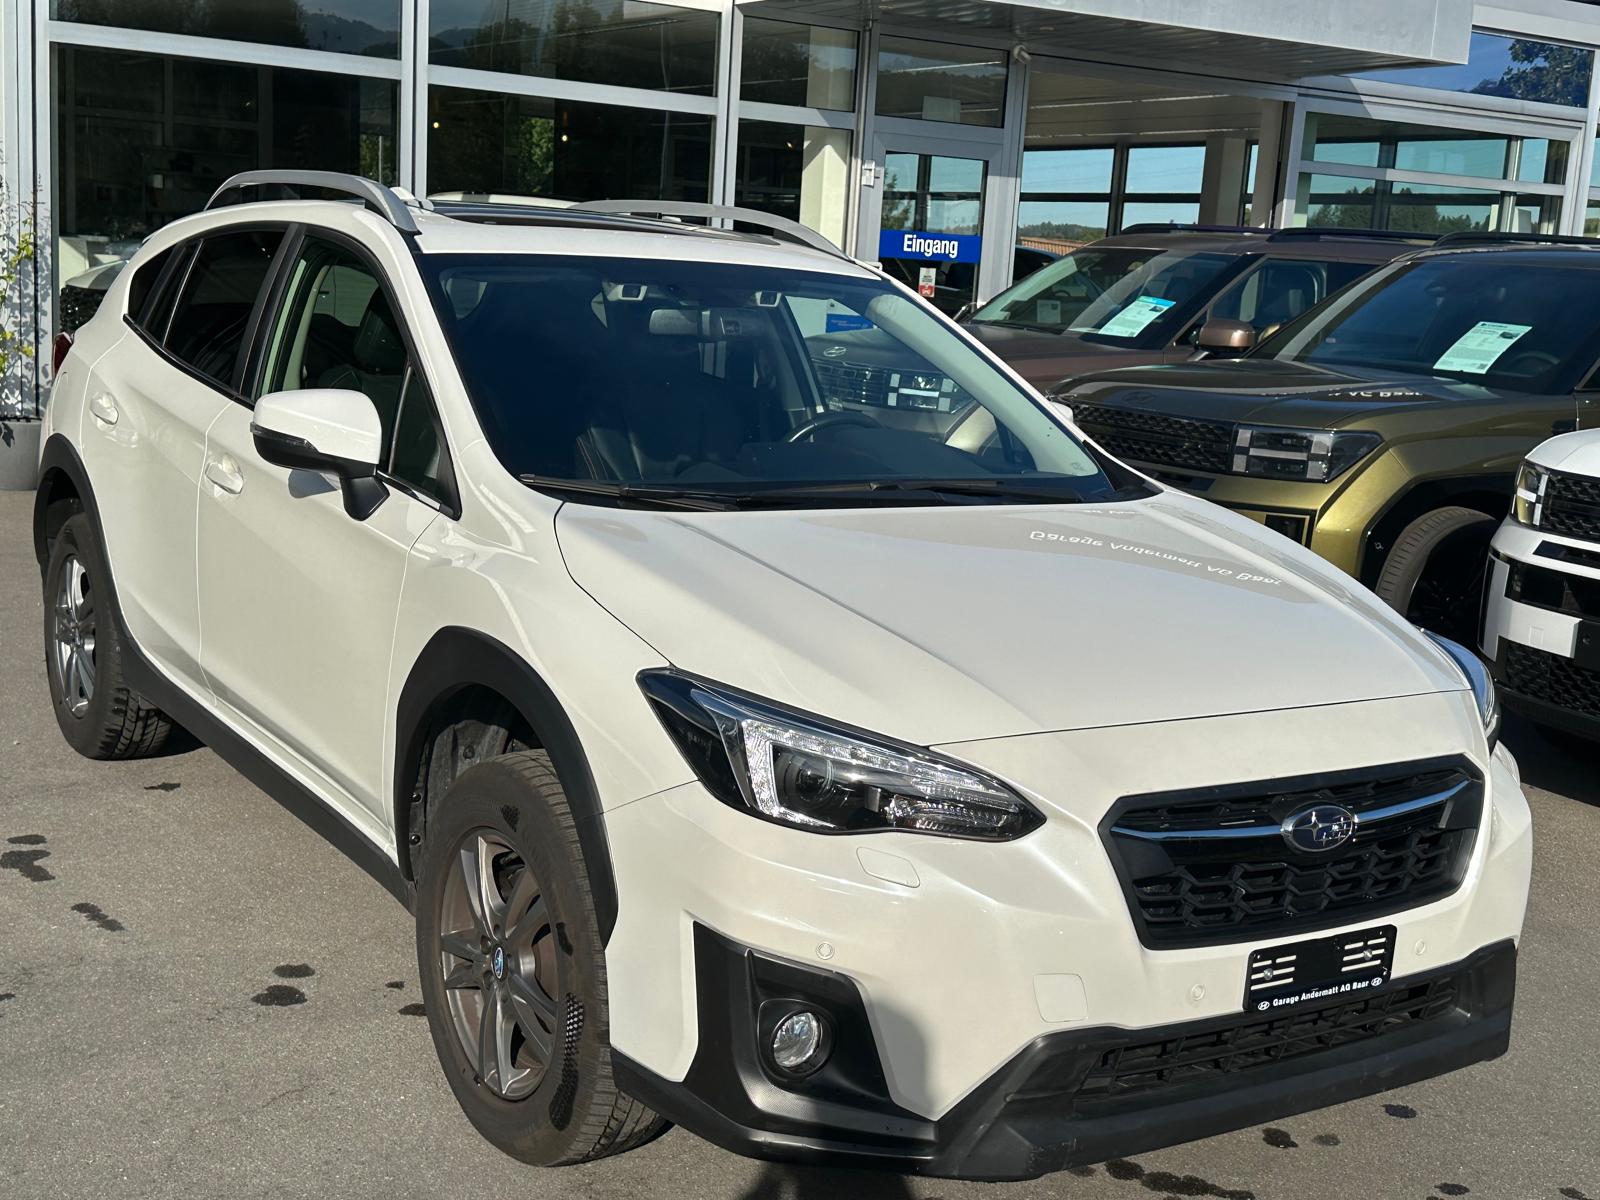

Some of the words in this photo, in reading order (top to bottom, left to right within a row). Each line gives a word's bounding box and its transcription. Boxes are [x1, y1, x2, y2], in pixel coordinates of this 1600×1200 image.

[903, 234, 958, 258] Eingang
[1272, 995, 1299, 1007] Garage
[1301, 987, 1339, 1001] Andermatt
[1340, 983, 1351, 993] AG
[1352, 980, 1369, 990] Baar
